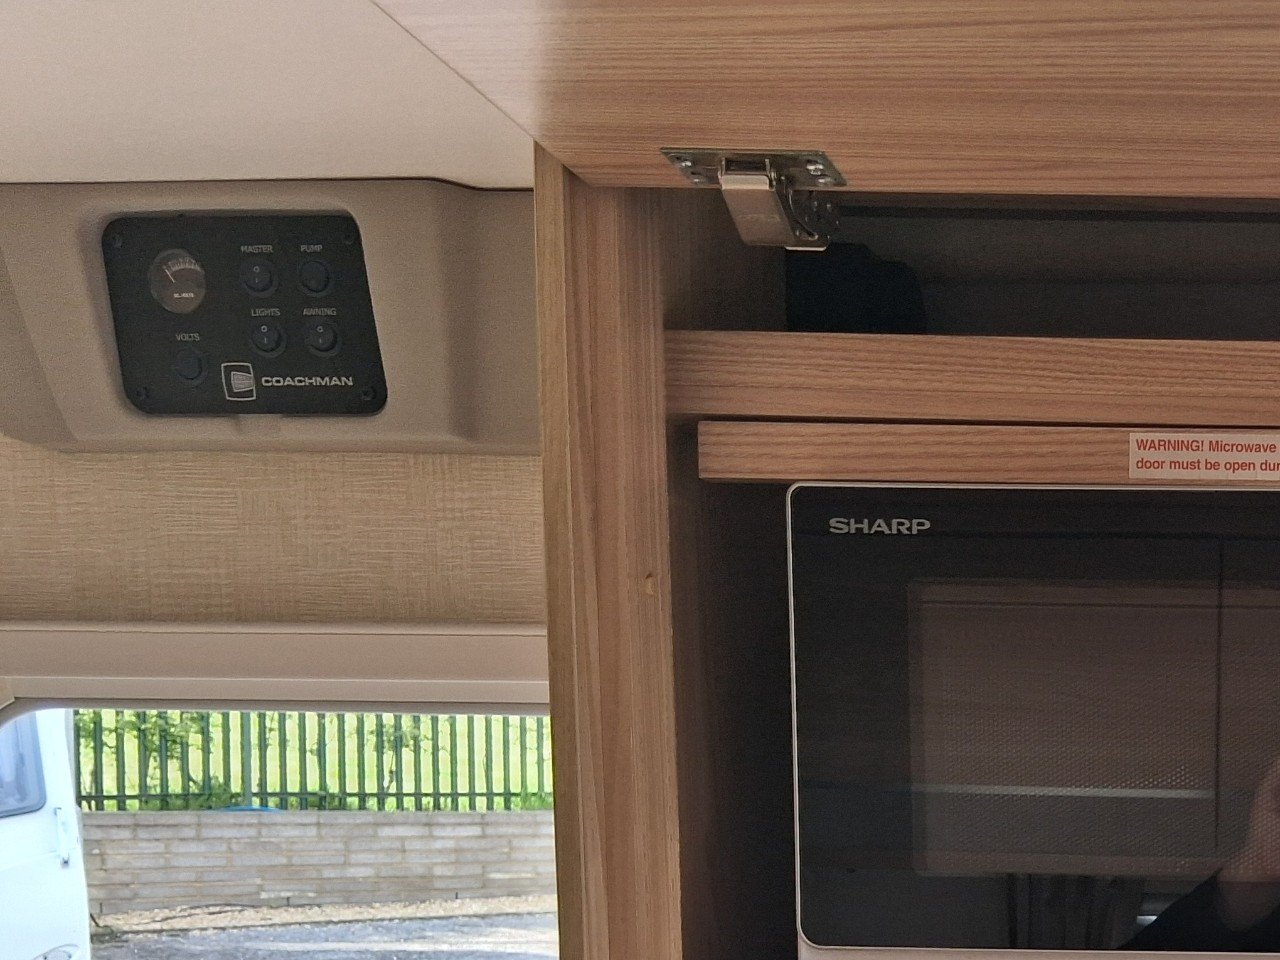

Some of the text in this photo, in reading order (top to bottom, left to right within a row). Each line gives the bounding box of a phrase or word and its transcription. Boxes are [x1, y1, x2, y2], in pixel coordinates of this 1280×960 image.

[241, 244, 273, 253] MASTER
[301, 244, 323, 253] PUMP
[251, 308, 281, 317] LIGHTS
[303, 308, 337, 317] AWNING
[175, 333, 200, 342] VOLTS
[261, 376, 354, 387] COACHMAN
[1136, 438, 1205, 452] WARNING!
[1208, 440, 1277, 454] Microwave
[1136, 457, 1165, 470] door
[1169, 459, 1202, 471] must
[1205, 458, 1221, 471] be
[1224, 460, 1256, 474] open
[828, 517, 931, 535] SHARP
